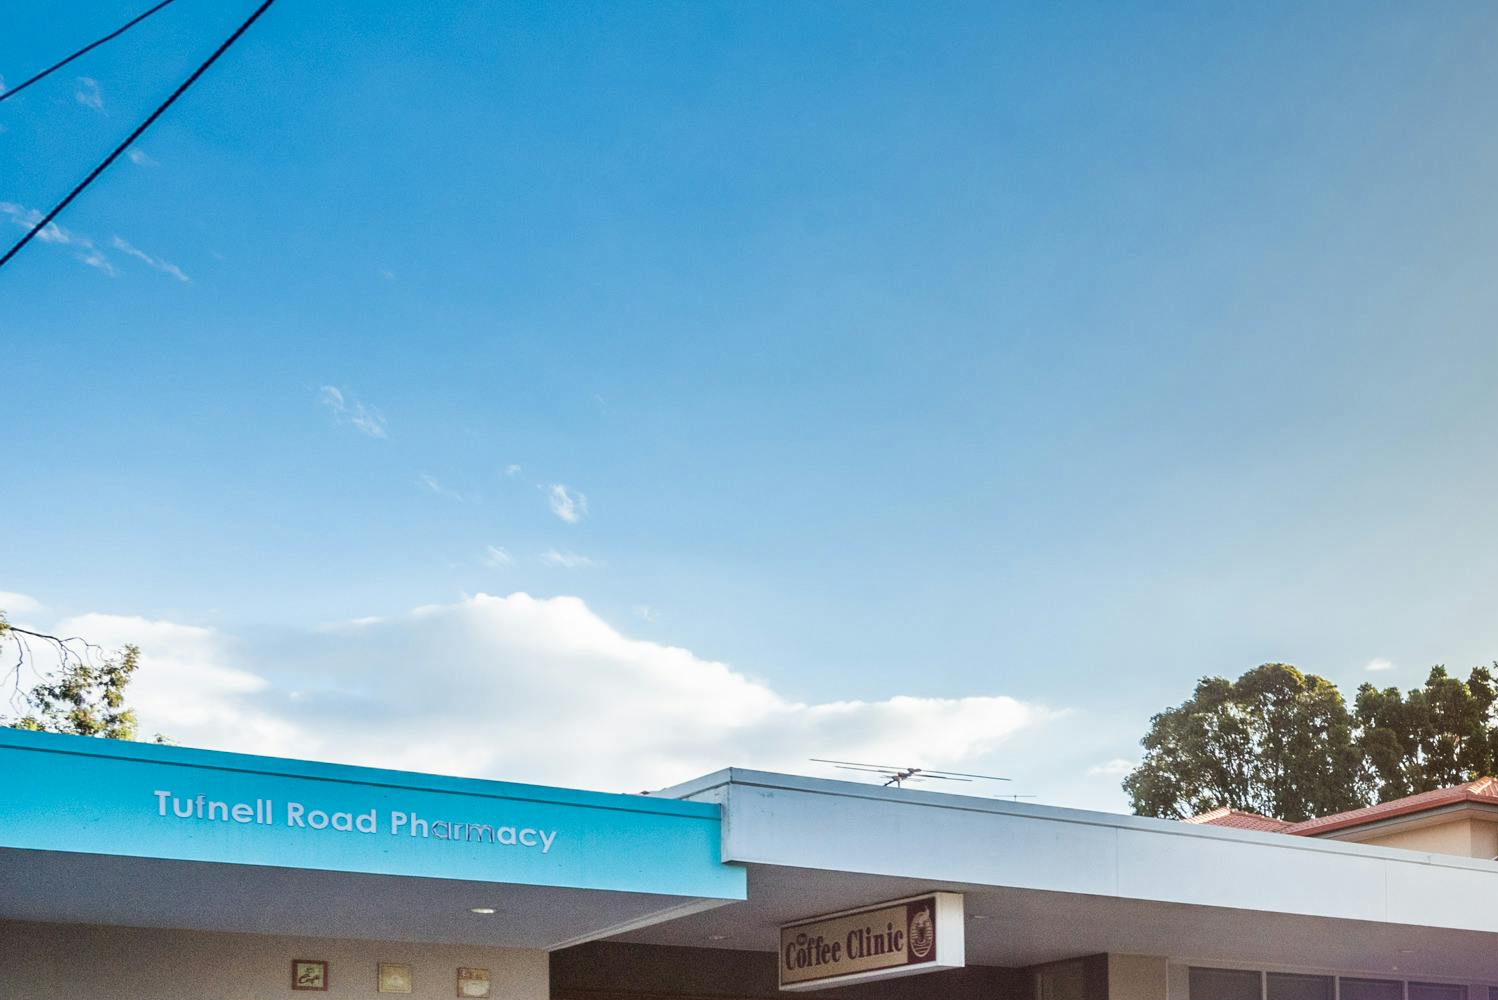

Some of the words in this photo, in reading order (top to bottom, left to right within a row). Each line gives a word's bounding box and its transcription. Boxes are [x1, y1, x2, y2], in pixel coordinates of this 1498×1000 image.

[154, 789, 273, 825] Tufnell
[287, 801, 377, 834] Road
[391, 810, 557, 854] Pharmacy
[785, 934, 841, 970] Coffee
[846, 921, 904, 960] Clinic
